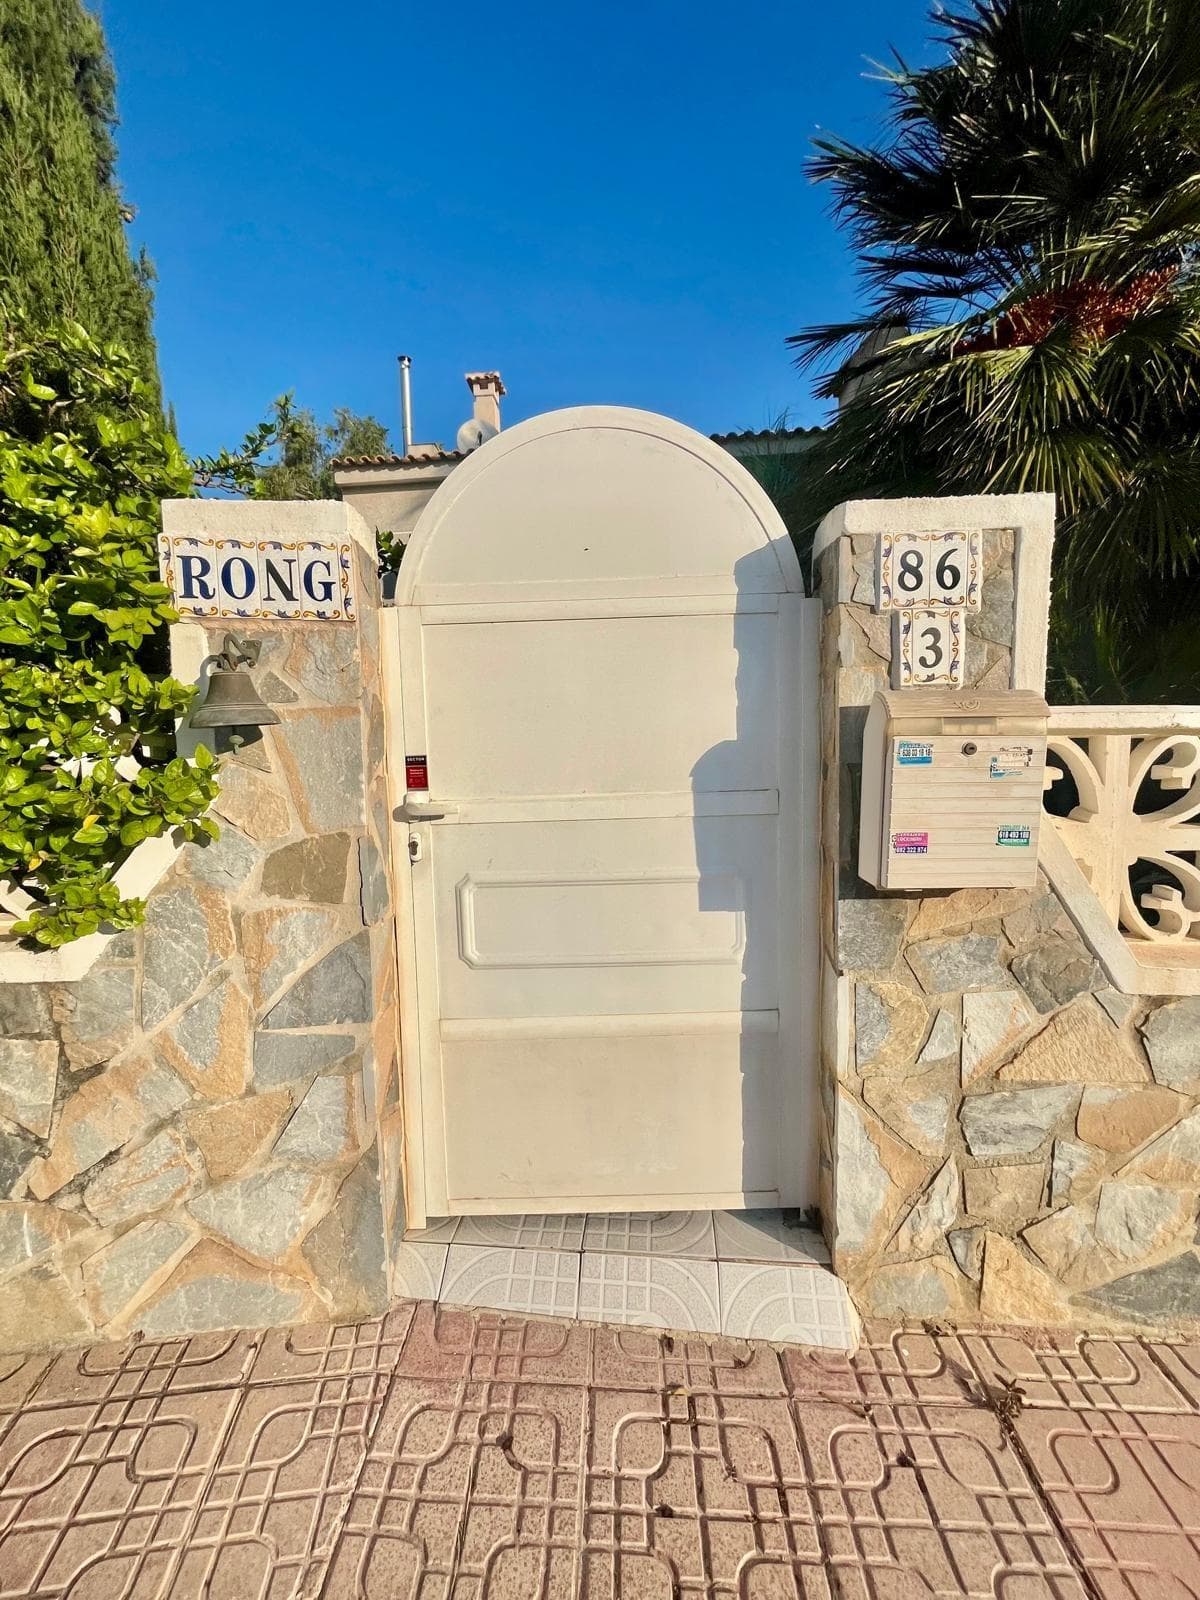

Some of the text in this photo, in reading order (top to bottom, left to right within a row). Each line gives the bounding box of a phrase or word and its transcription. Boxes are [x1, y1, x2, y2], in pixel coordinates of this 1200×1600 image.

[176, 555, 336, 602] RONG
[897, 548, 961, 592] 86
[918, 627, 943, 668] 3
